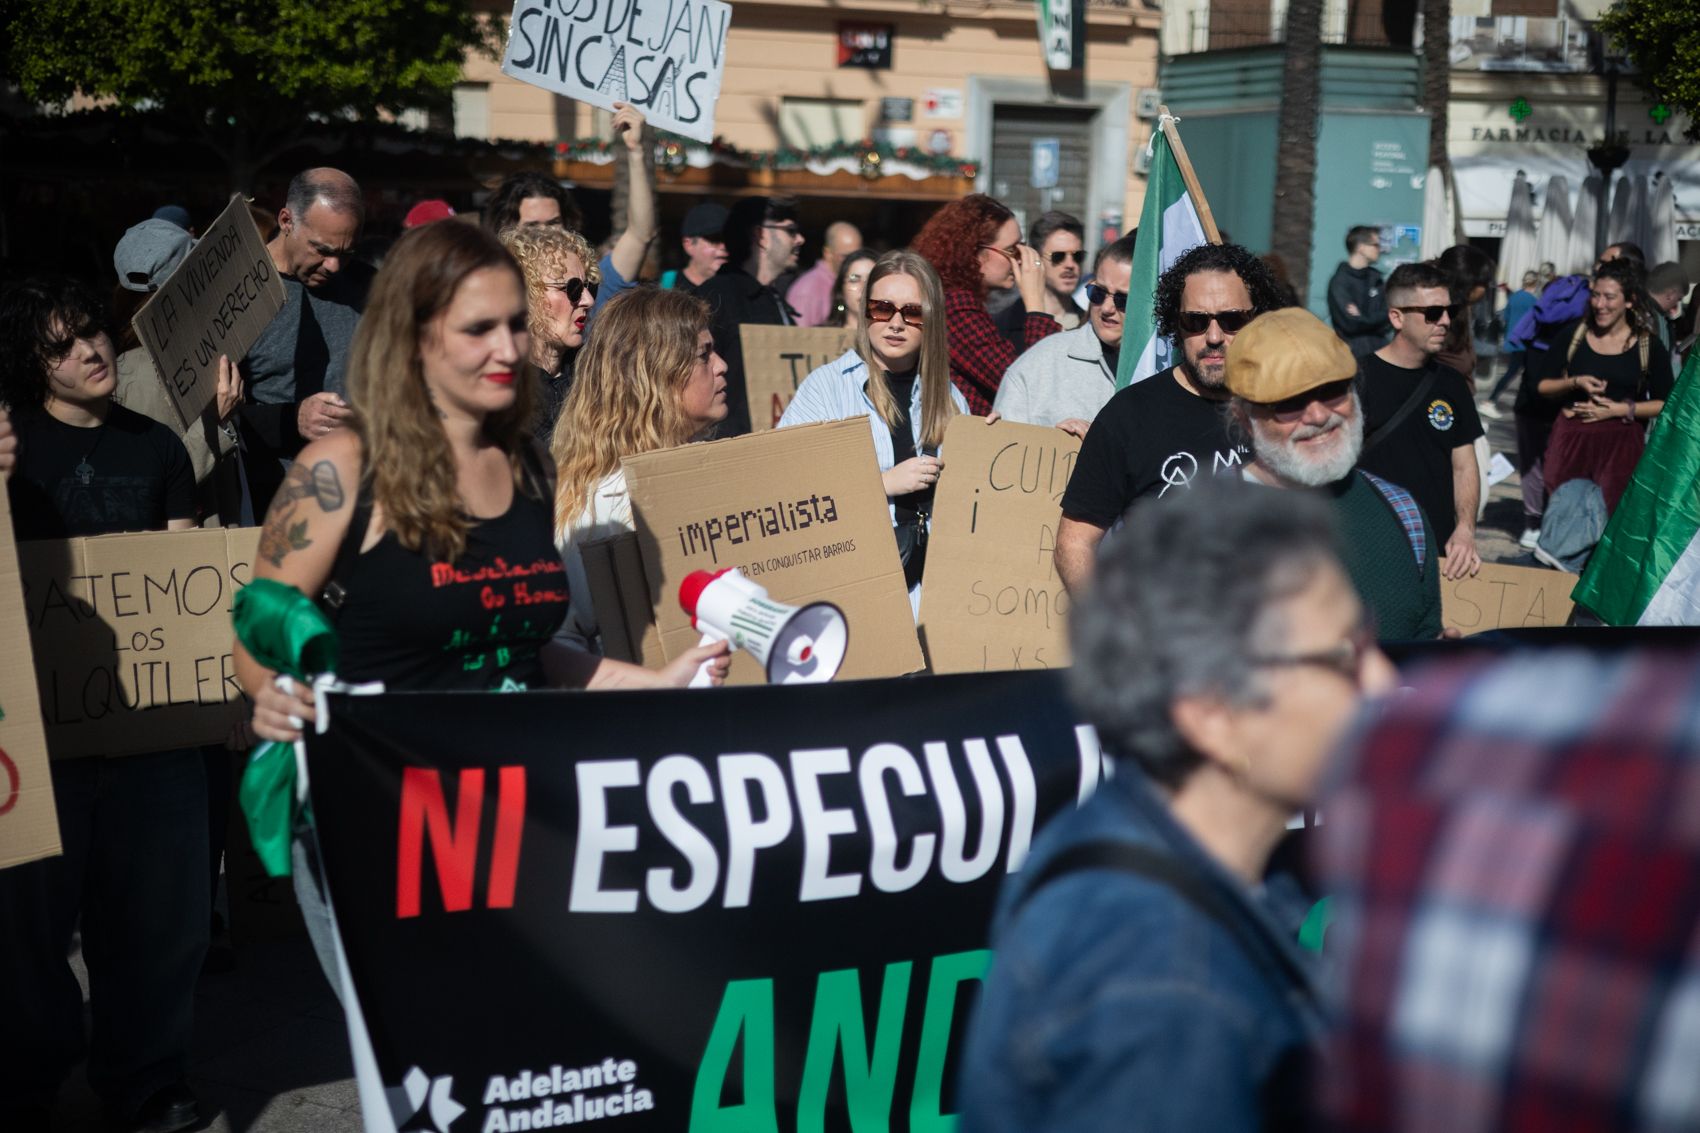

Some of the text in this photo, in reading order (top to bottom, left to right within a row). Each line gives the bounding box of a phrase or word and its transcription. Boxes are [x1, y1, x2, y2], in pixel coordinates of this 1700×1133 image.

[1471, 127, 1586, 143] FARMACIA
[151, 224, 242, 352] LA VIVIENDA
[172, 258, 270, 398] ES UN DERECHO
[678, 494, 838, 564] imperialista
[752, 563, 765, 576] EN
[767, 547, 822, 572] CONQUISTAR
[823, 539, 857, 559] BARRIOS
[113, 627, 165, 652] LOS
[397, 765, 527, 918] NI
[483, 1056, 637, 1105] Adelante
[481, 1083, 655, 1133] Andalucía
